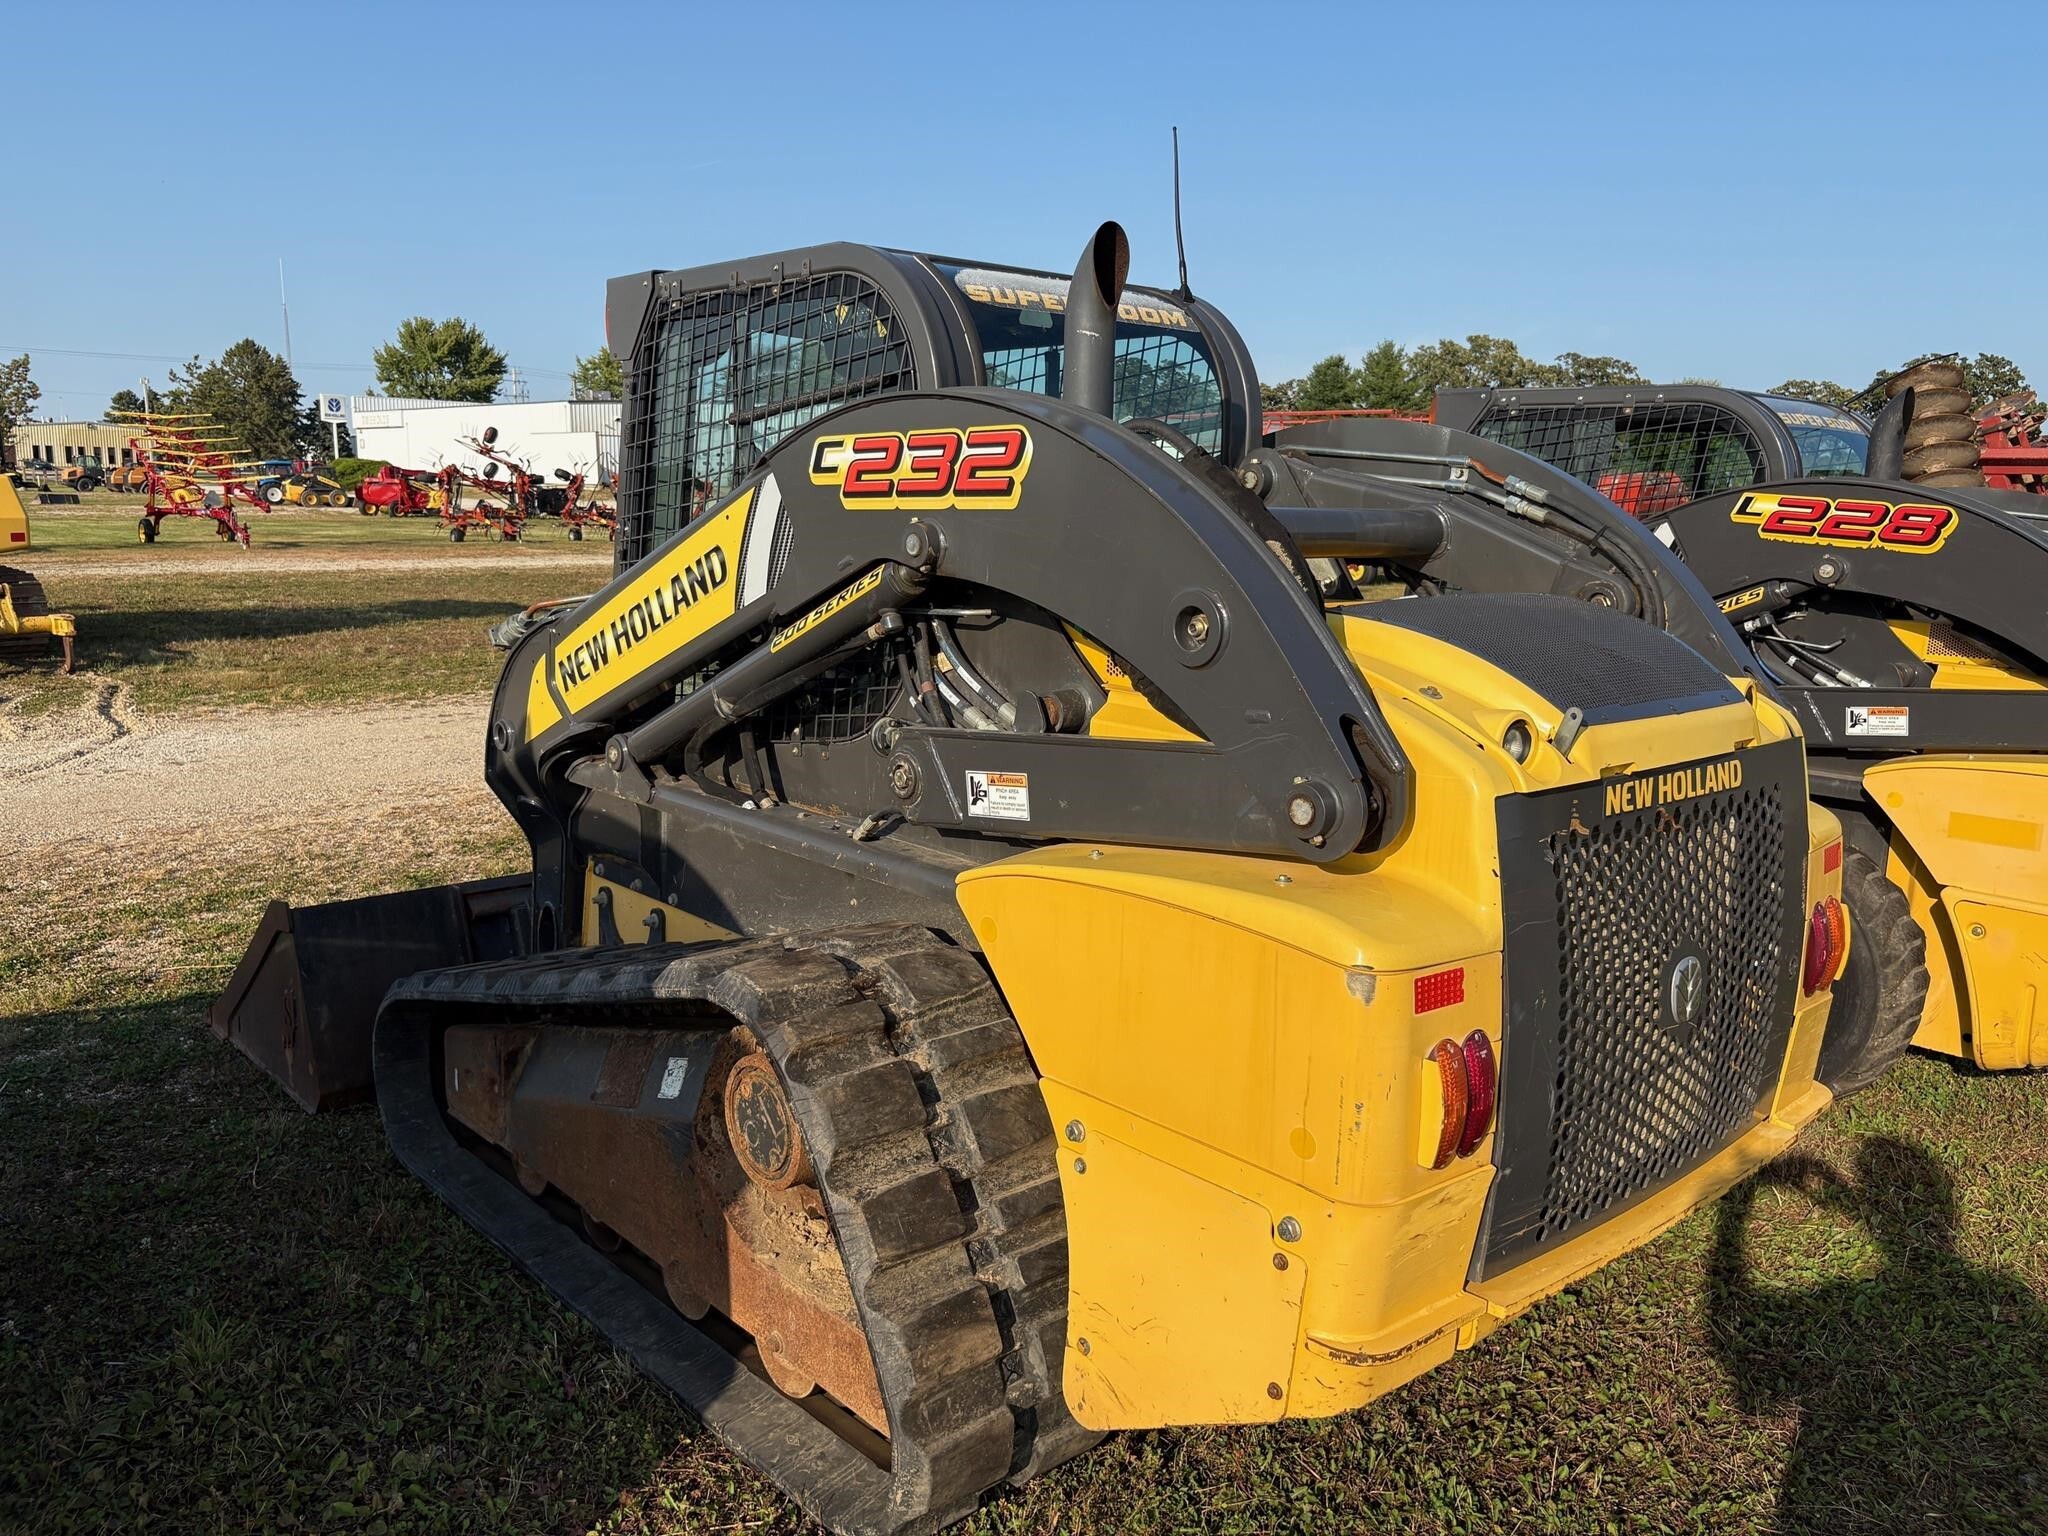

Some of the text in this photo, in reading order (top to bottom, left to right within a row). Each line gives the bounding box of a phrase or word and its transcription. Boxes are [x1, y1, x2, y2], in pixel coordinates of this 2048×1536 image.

[965, 284, 1187, 327] SUPE OOM
[1777, 412, 1825, 427] SUPER
[811, 428, 1028, 501] C232
[1734, 496, 1954, 548] L228
[558, 544, 728, 693] NEW HOLLAND
[773, 570, 880, 648] 200 SERIES
[1717, 588, 1762, 610] RIES
[996, 776, 1024, 784] WARNING
[1605, 759, 1743, 816] NEW HOLLAND
